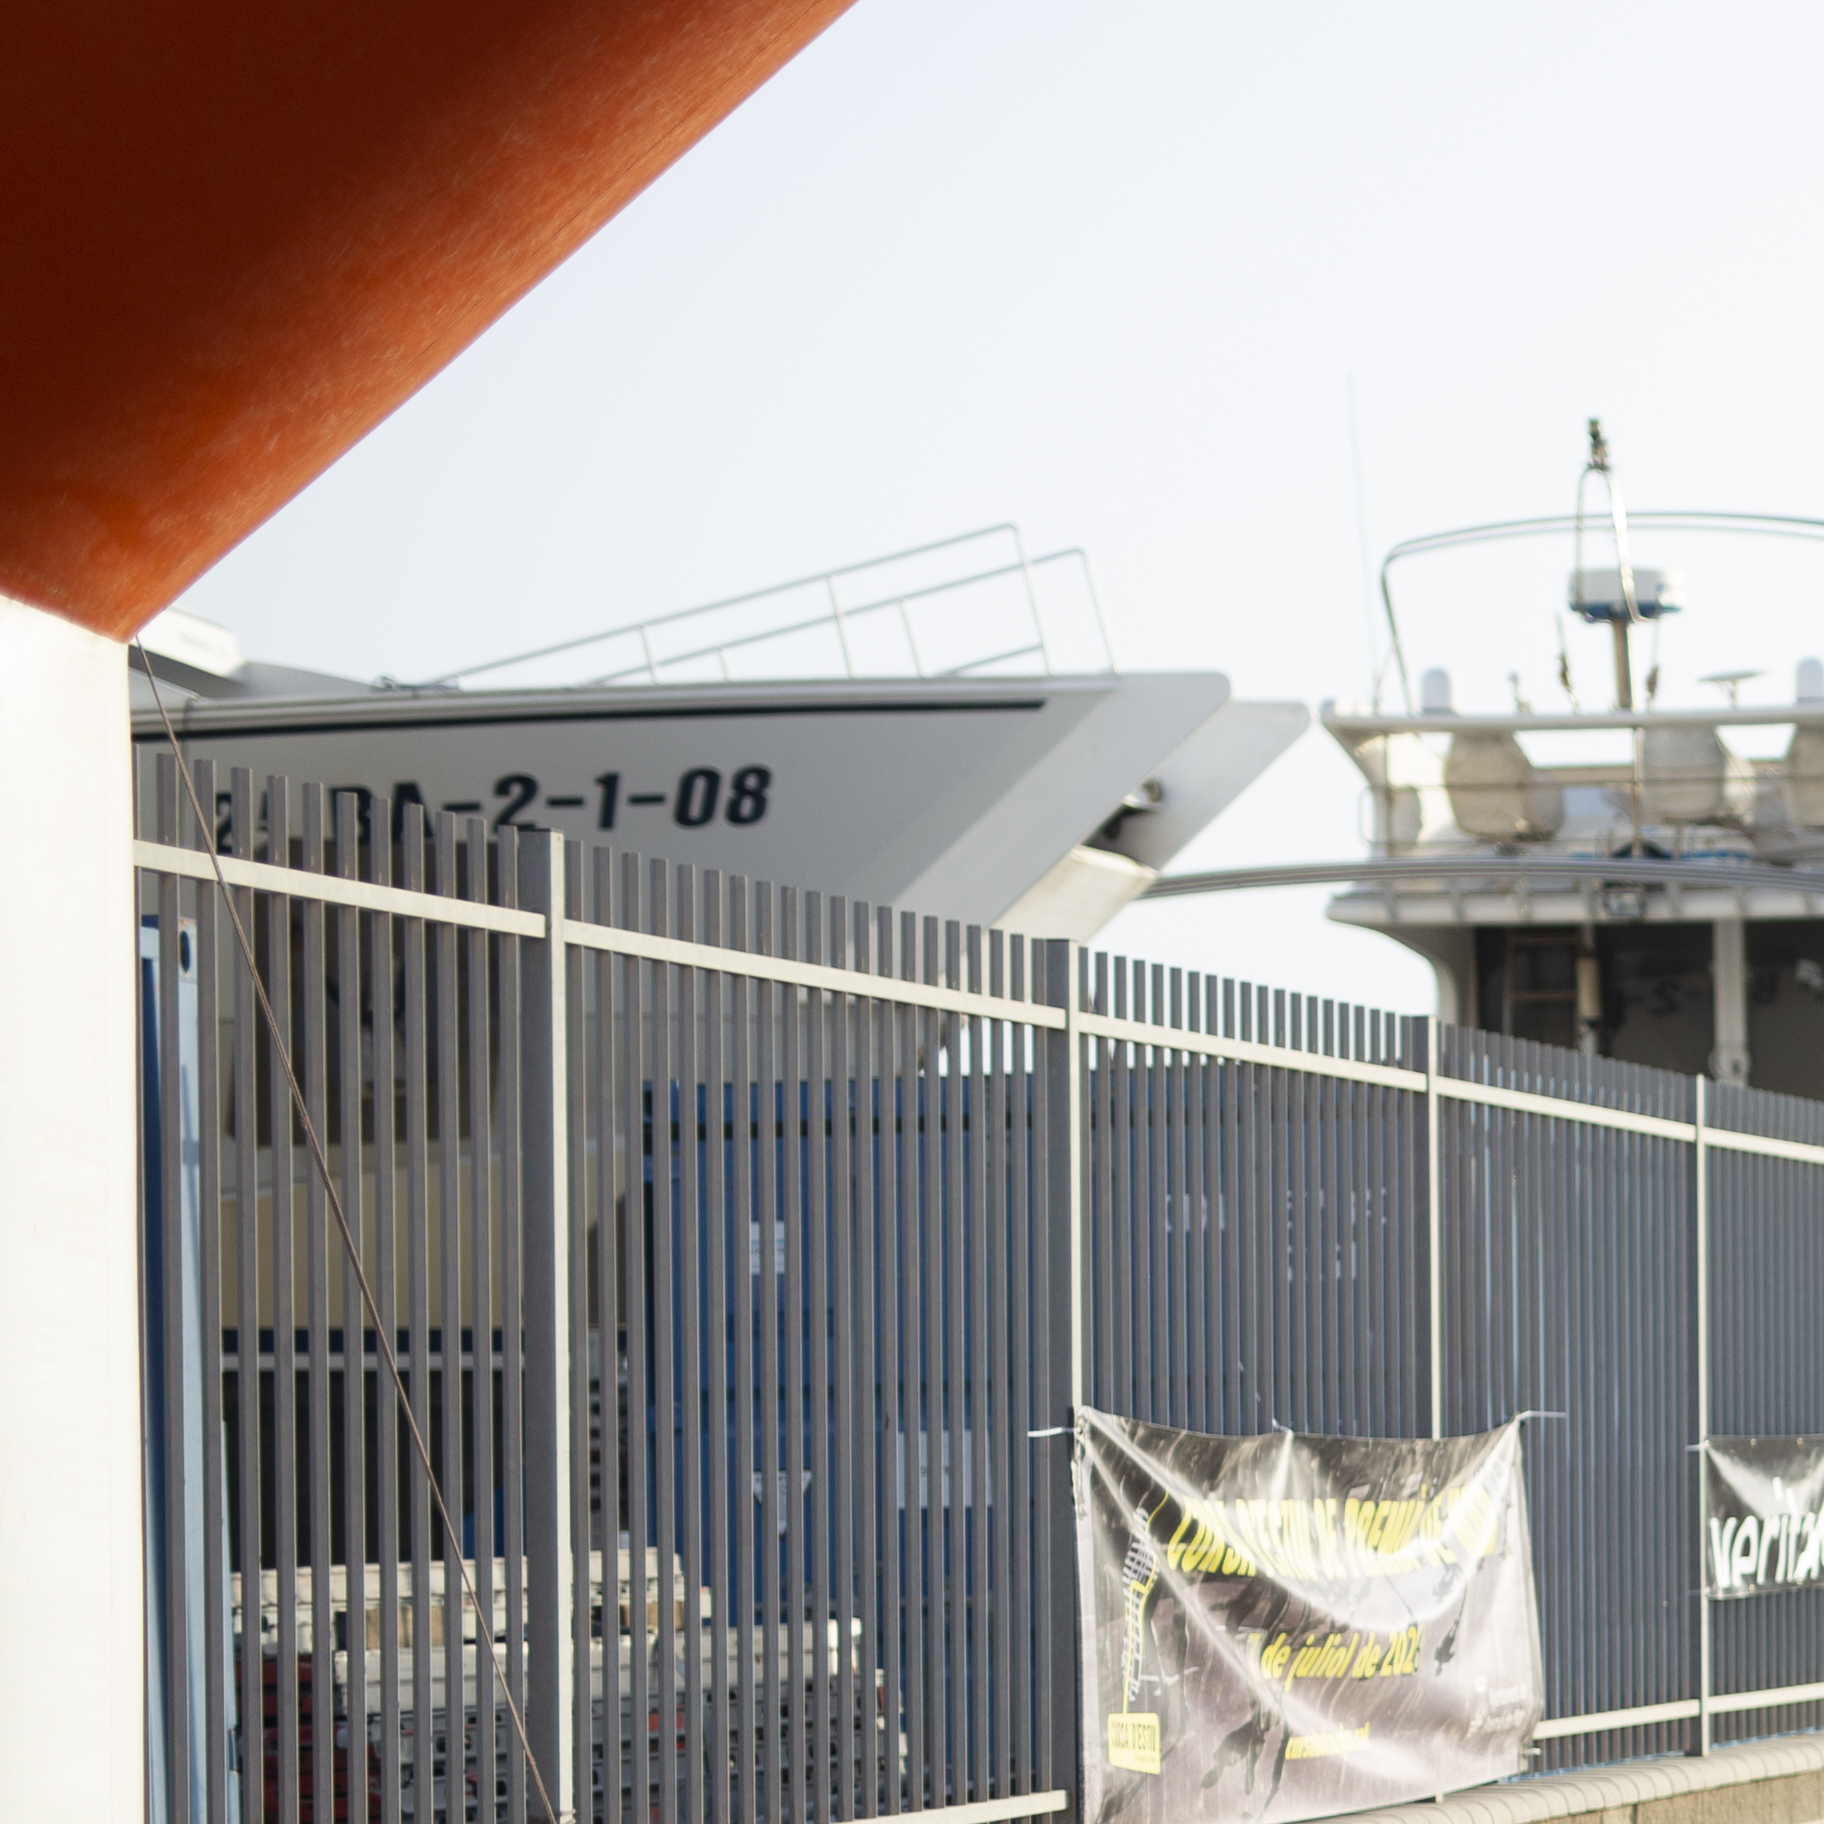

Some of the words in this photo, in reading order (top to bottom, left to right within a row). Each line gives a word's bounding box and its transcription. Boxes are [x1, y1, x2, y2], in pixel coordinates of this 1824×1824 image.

[1261, 1633, 1291, 1680] de
[1284, 1633, 1360, 1693] juliol
[1351, 1632, 1381, 1679] de
